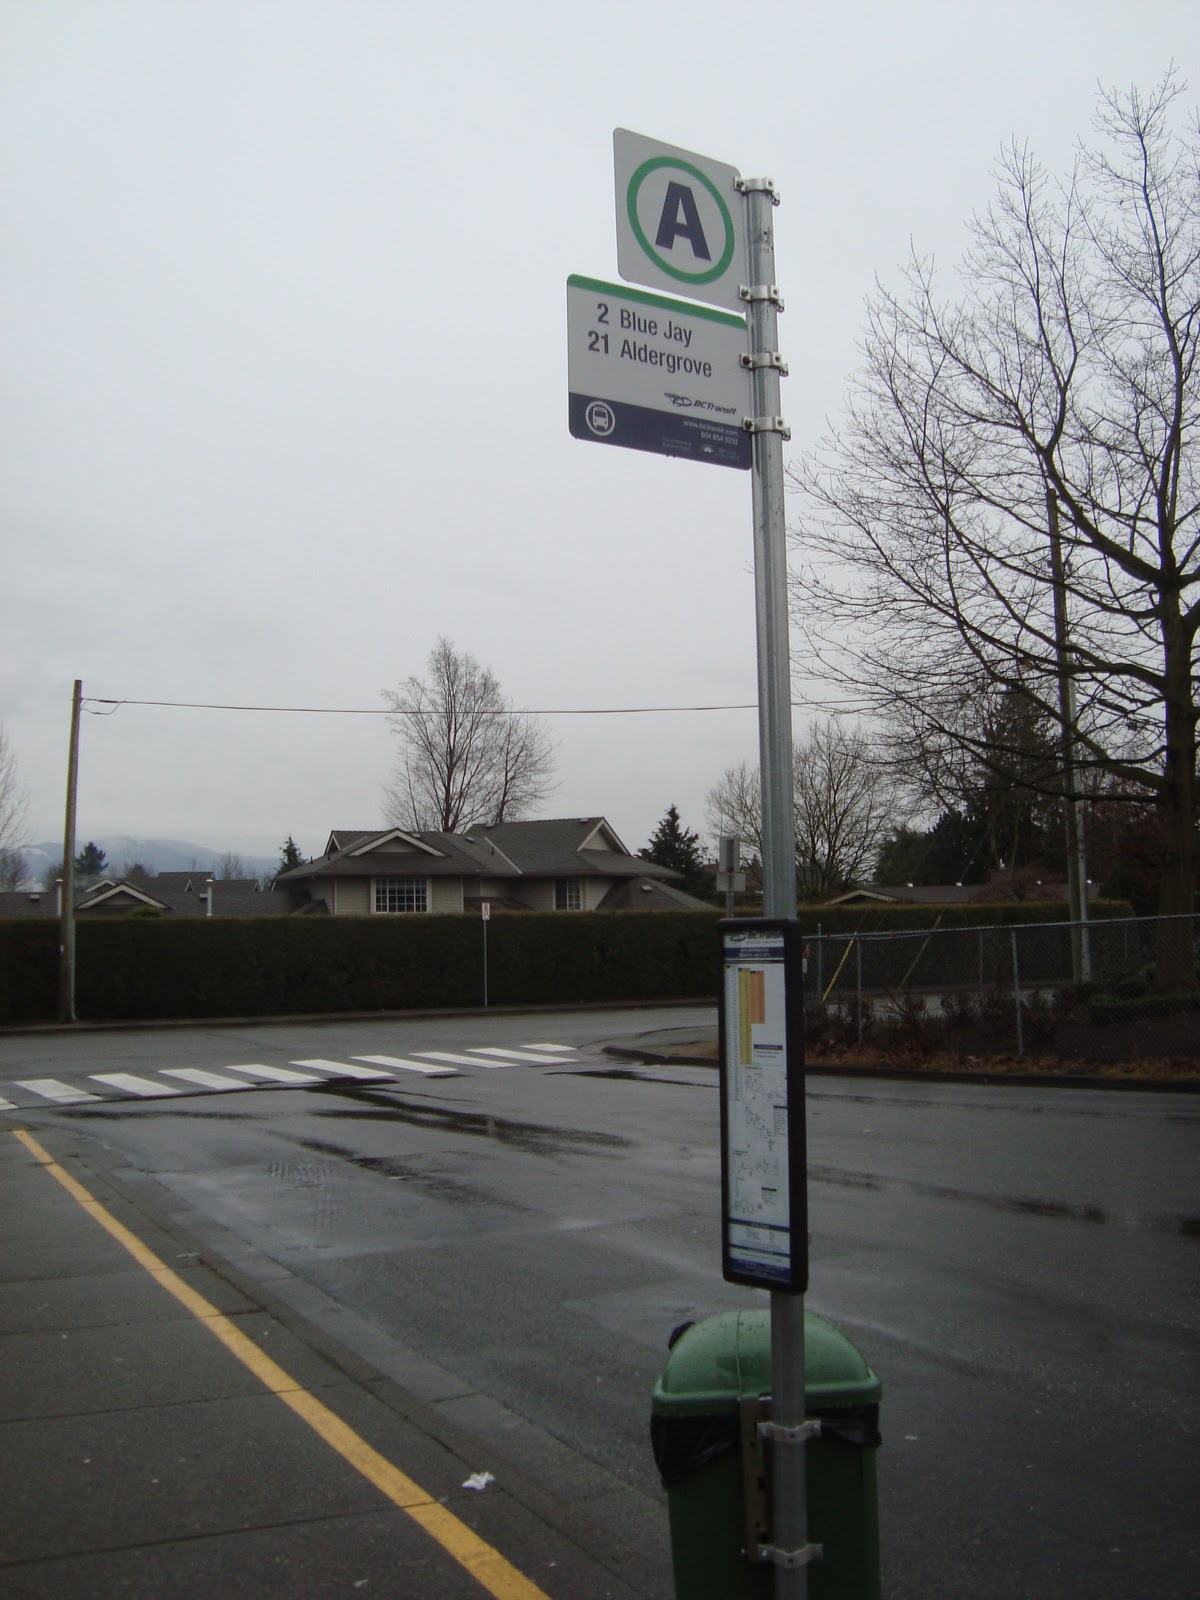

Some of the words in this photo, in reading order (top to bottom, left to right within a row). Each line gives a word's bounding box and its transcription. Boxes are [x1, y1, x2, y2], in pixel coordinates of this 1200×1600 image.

[655, 180, 711, 261] A
[597, 303, 610, 324] 2
[620, 308, 658, 336] Blue
[664, 318, 692, 347] Jay
[588, 331, 610, 354] 21
[621, 339, 712, 377] Aldergrove
[682, 420, 739, 436] www.bctransit.com
